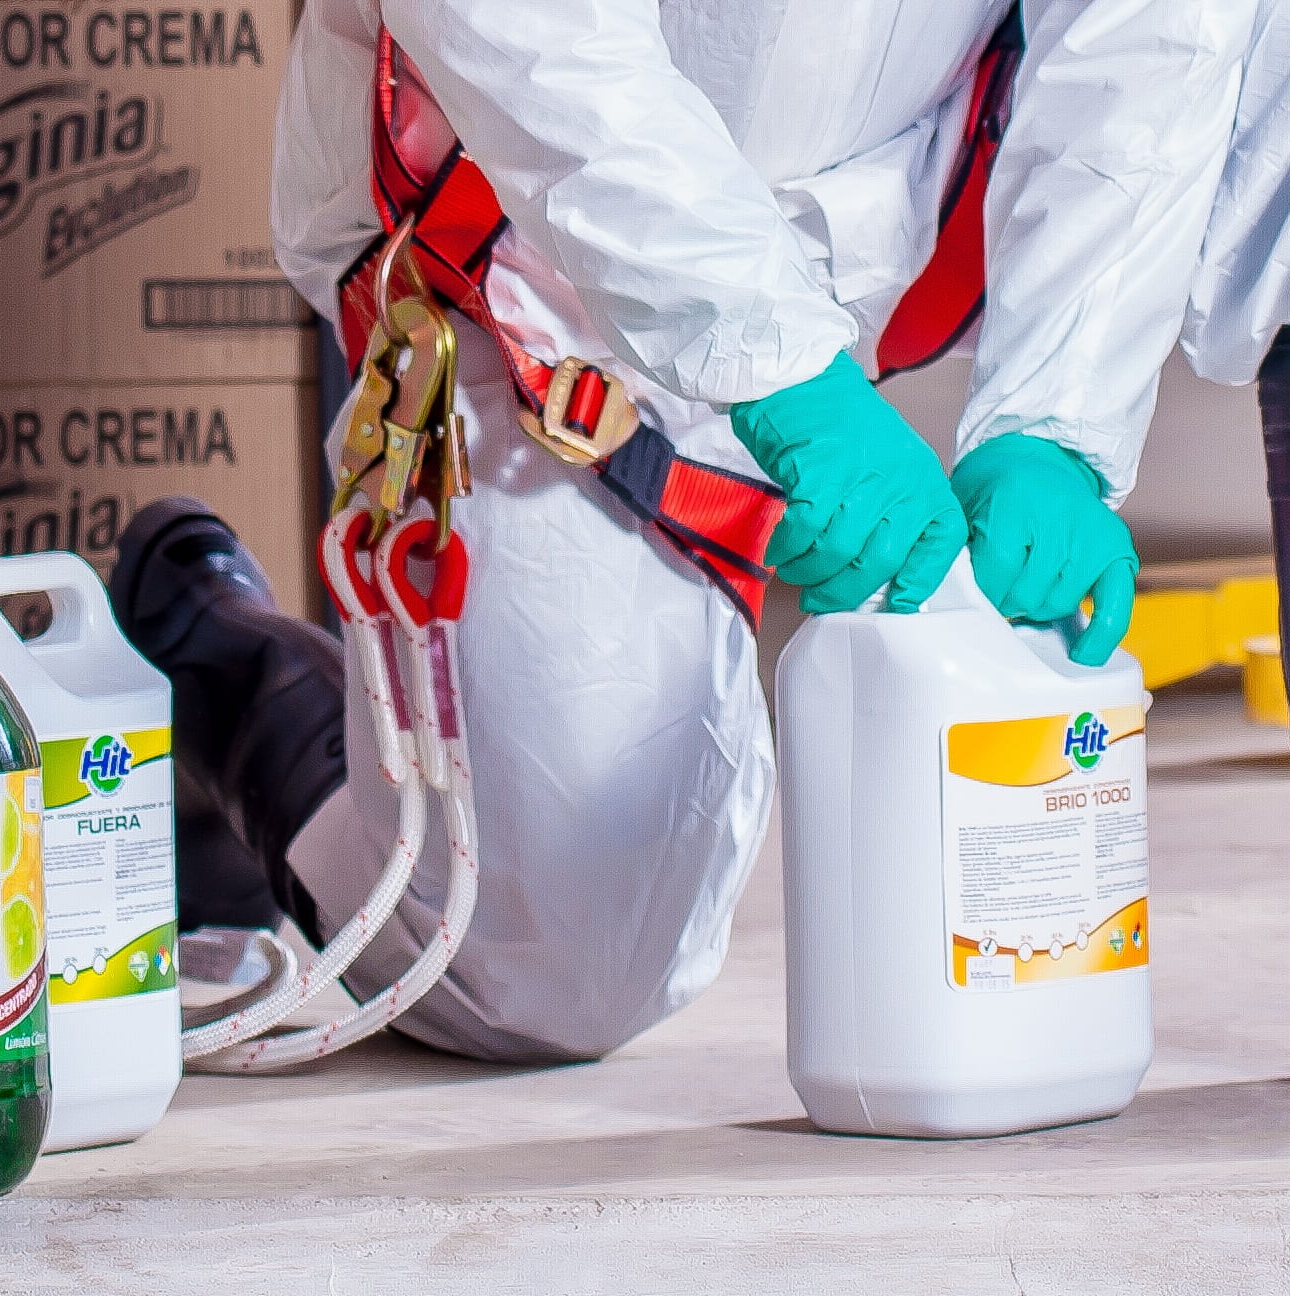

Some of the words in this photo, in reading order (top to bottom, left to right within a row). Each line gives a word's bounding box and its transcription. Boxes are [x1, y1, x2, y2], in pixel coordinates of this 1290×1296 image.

[86, 8, 264, 70] CREMA
[60, 407, 239, 466] CREMA
[1064, 717, 1110, 756] Hit
[81, 741, 132, 780] Hit
[1045, 793, 1087, 813] BRIO
[1092, 786, 1131, 806] 1000
[77, 814, 141, 836] FUERA
